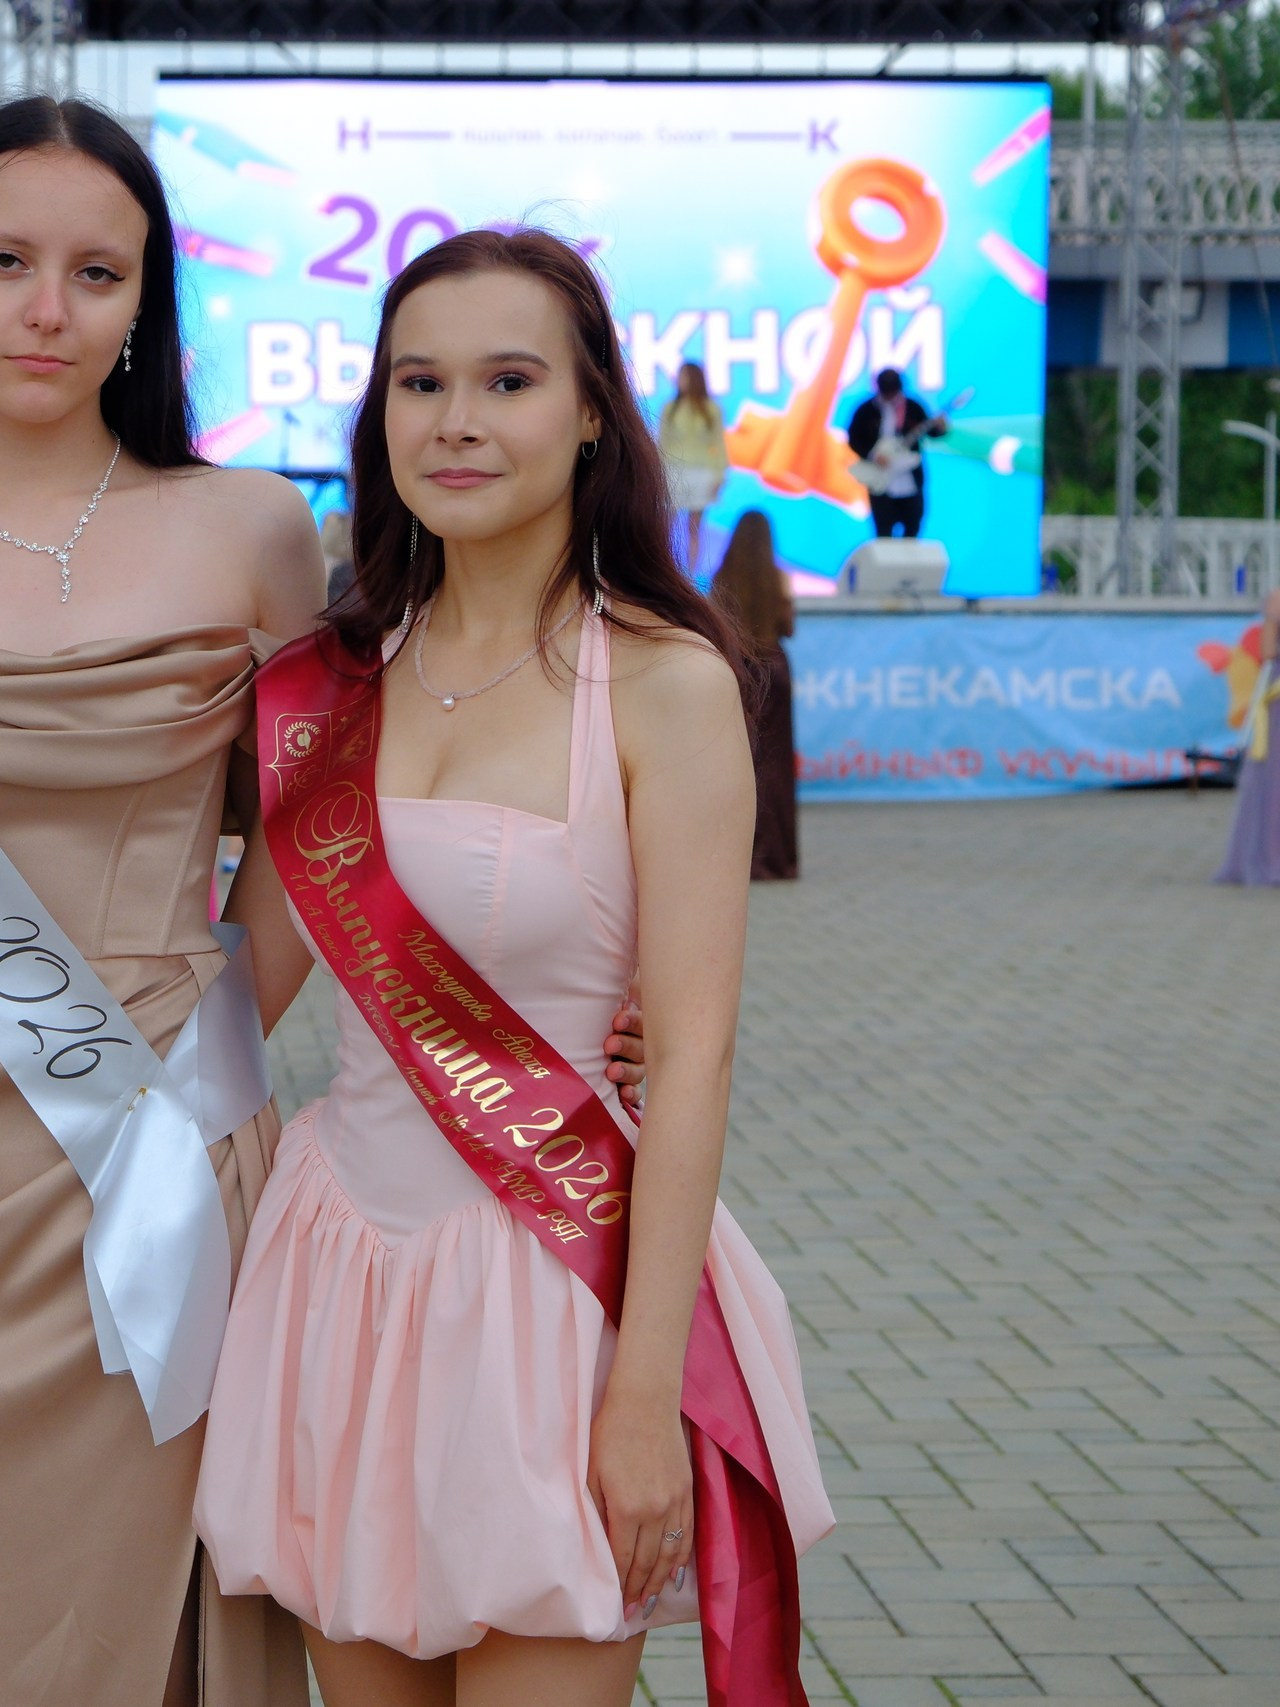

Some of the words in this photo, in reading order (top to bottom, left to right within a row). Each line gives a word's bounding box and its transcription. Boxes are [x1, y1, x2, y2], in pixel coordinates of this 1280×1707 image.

[249, 285, 945, 404] ВЫКНОЙ
[290, 872, 310, 892] 11
[315, 922, 342, 960] класс
[438, 1111, 469, 1133] №
[490, 1159, 547, 1205] НМР
[294, 781, 515, 1114] Выпускница
[503, 1107, 631, 1226] 2026
[397, 929, 494, 1023] Махмутова
[492, 1028, 551, 1080] Аделя
